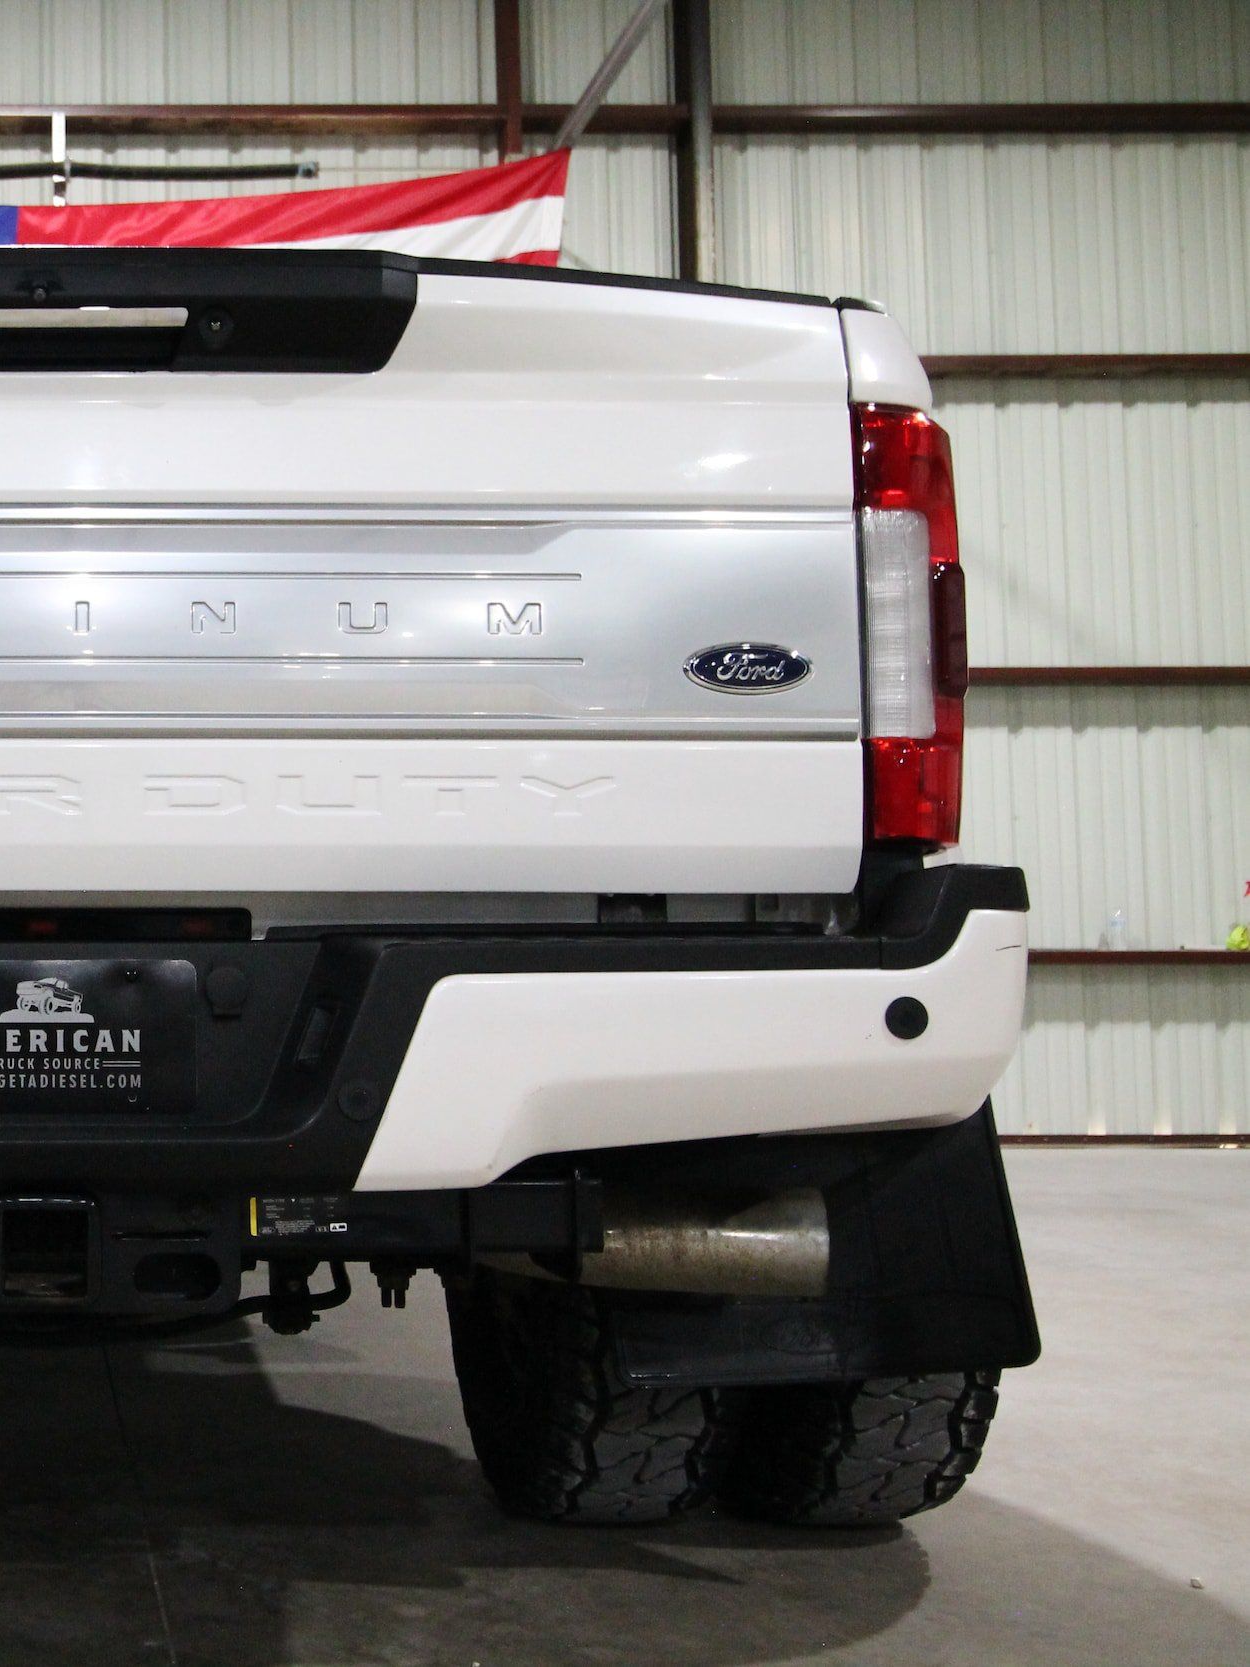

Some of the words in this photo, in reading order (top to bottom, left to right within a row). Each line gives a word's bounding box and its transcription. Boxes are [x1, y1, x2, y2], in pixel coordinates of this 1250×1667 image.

[716, 652, 785, 681] Ford
[144, 775, 617, 817] DUTY
[43, 1058, 100, 1070] SOURCE
